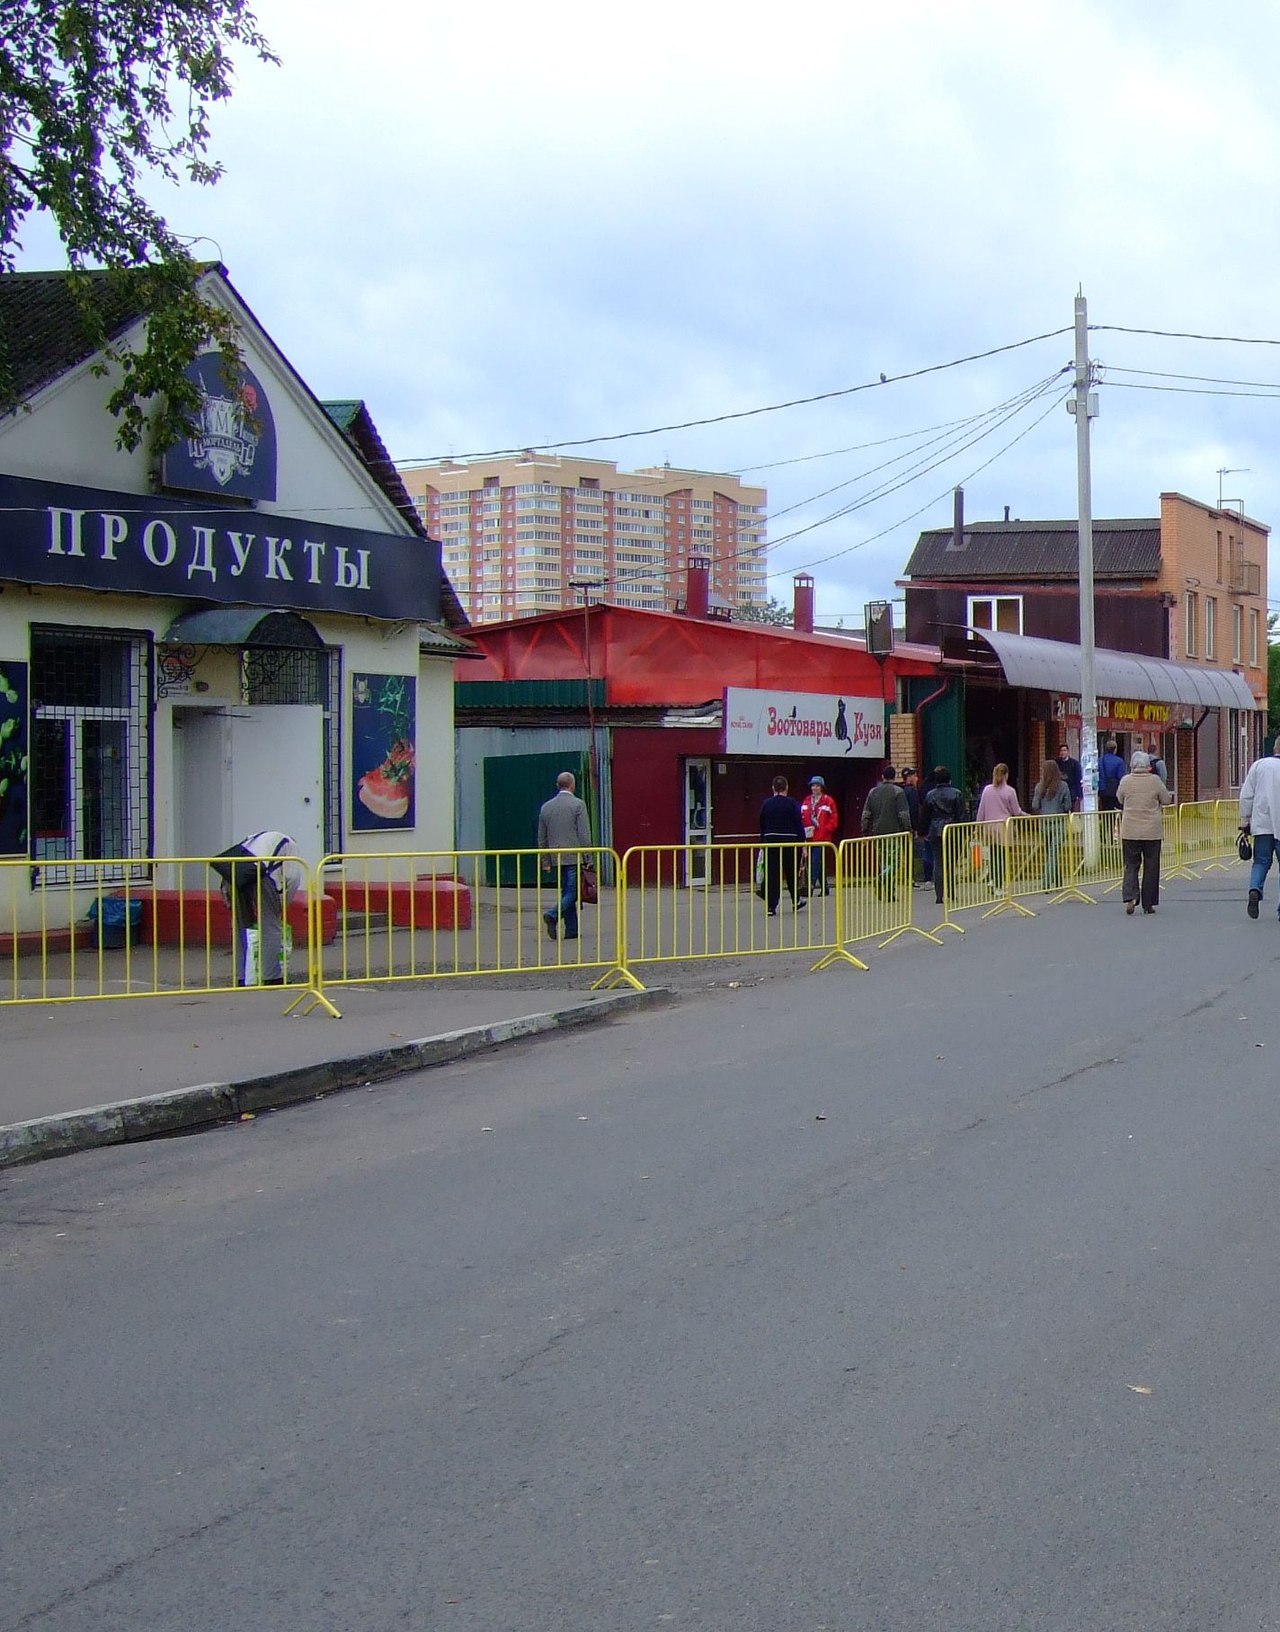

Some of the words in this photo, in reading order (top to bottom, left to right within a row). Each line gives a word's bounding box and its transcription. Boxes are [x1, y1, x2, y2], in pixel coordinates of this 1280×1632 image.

[48, 506, 372, 591] ПРОДУКТЫ
[767, 706, 833, 745] Зоотовары
[853, 711, 882, 747] Кузя
